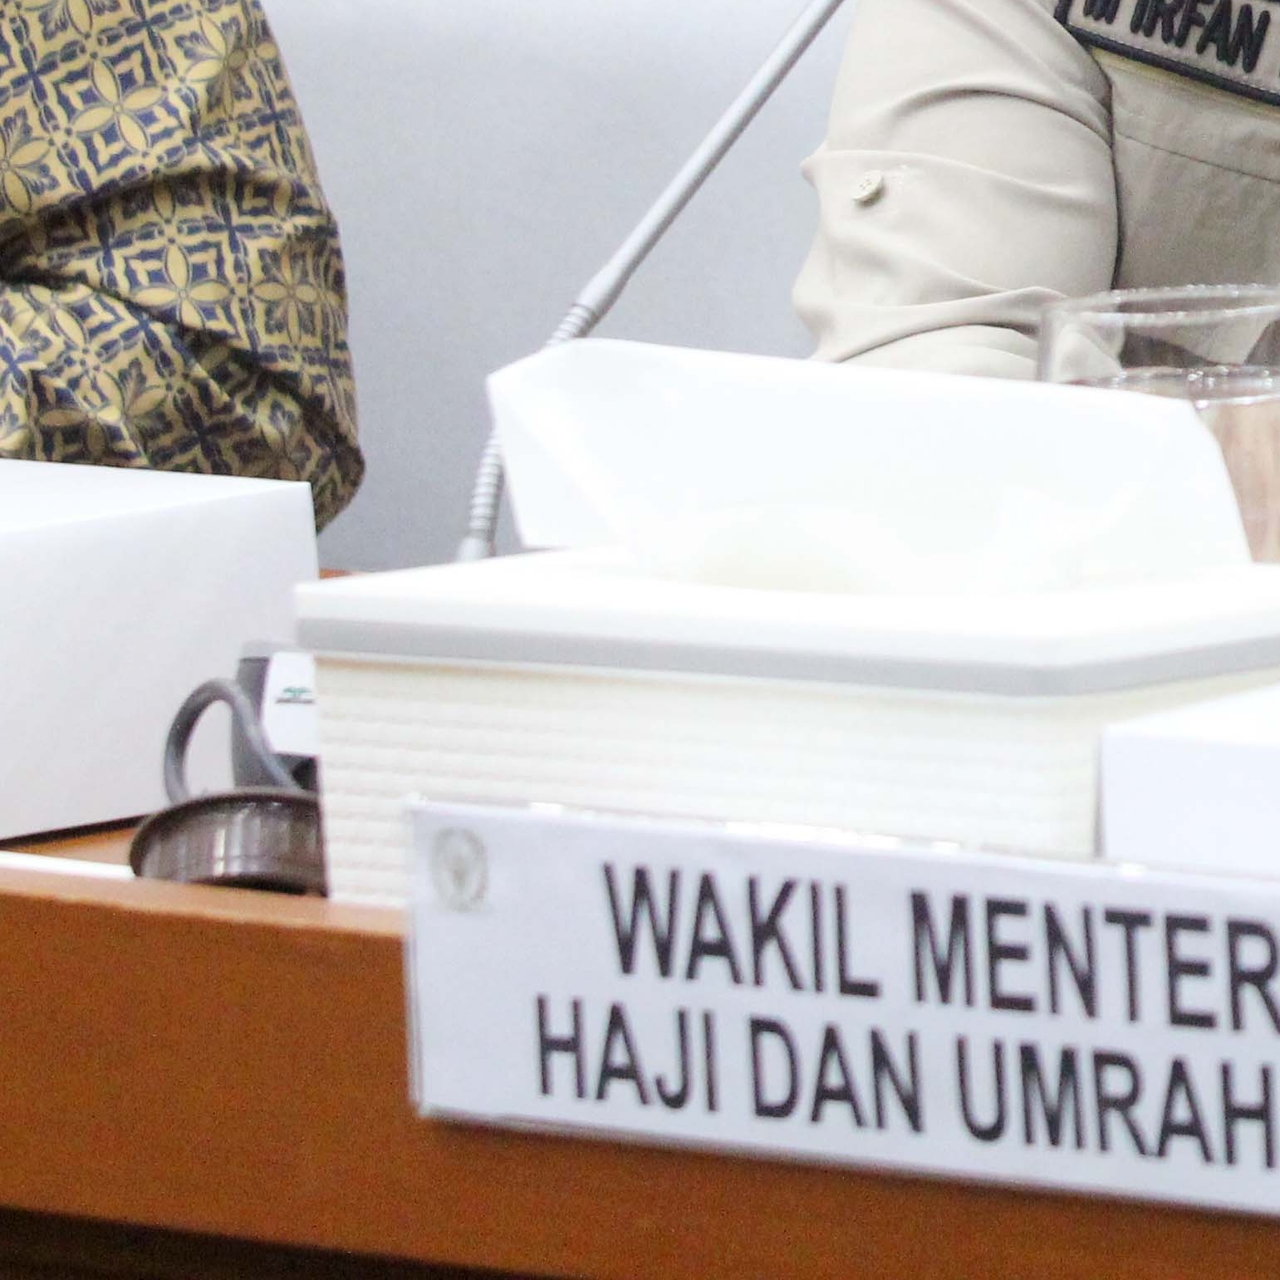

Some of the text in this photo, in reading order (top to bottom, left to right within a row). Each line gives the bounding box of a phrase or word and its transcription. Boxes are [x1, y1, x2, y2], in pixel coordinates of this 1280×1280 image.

[603, 862, 879, 999] WAKIL
[535, 995, 719, 1112] HAJI
[747, 1018, 924, 1133] DAN
[955, 1035, 1278, 1169] UMRAH
